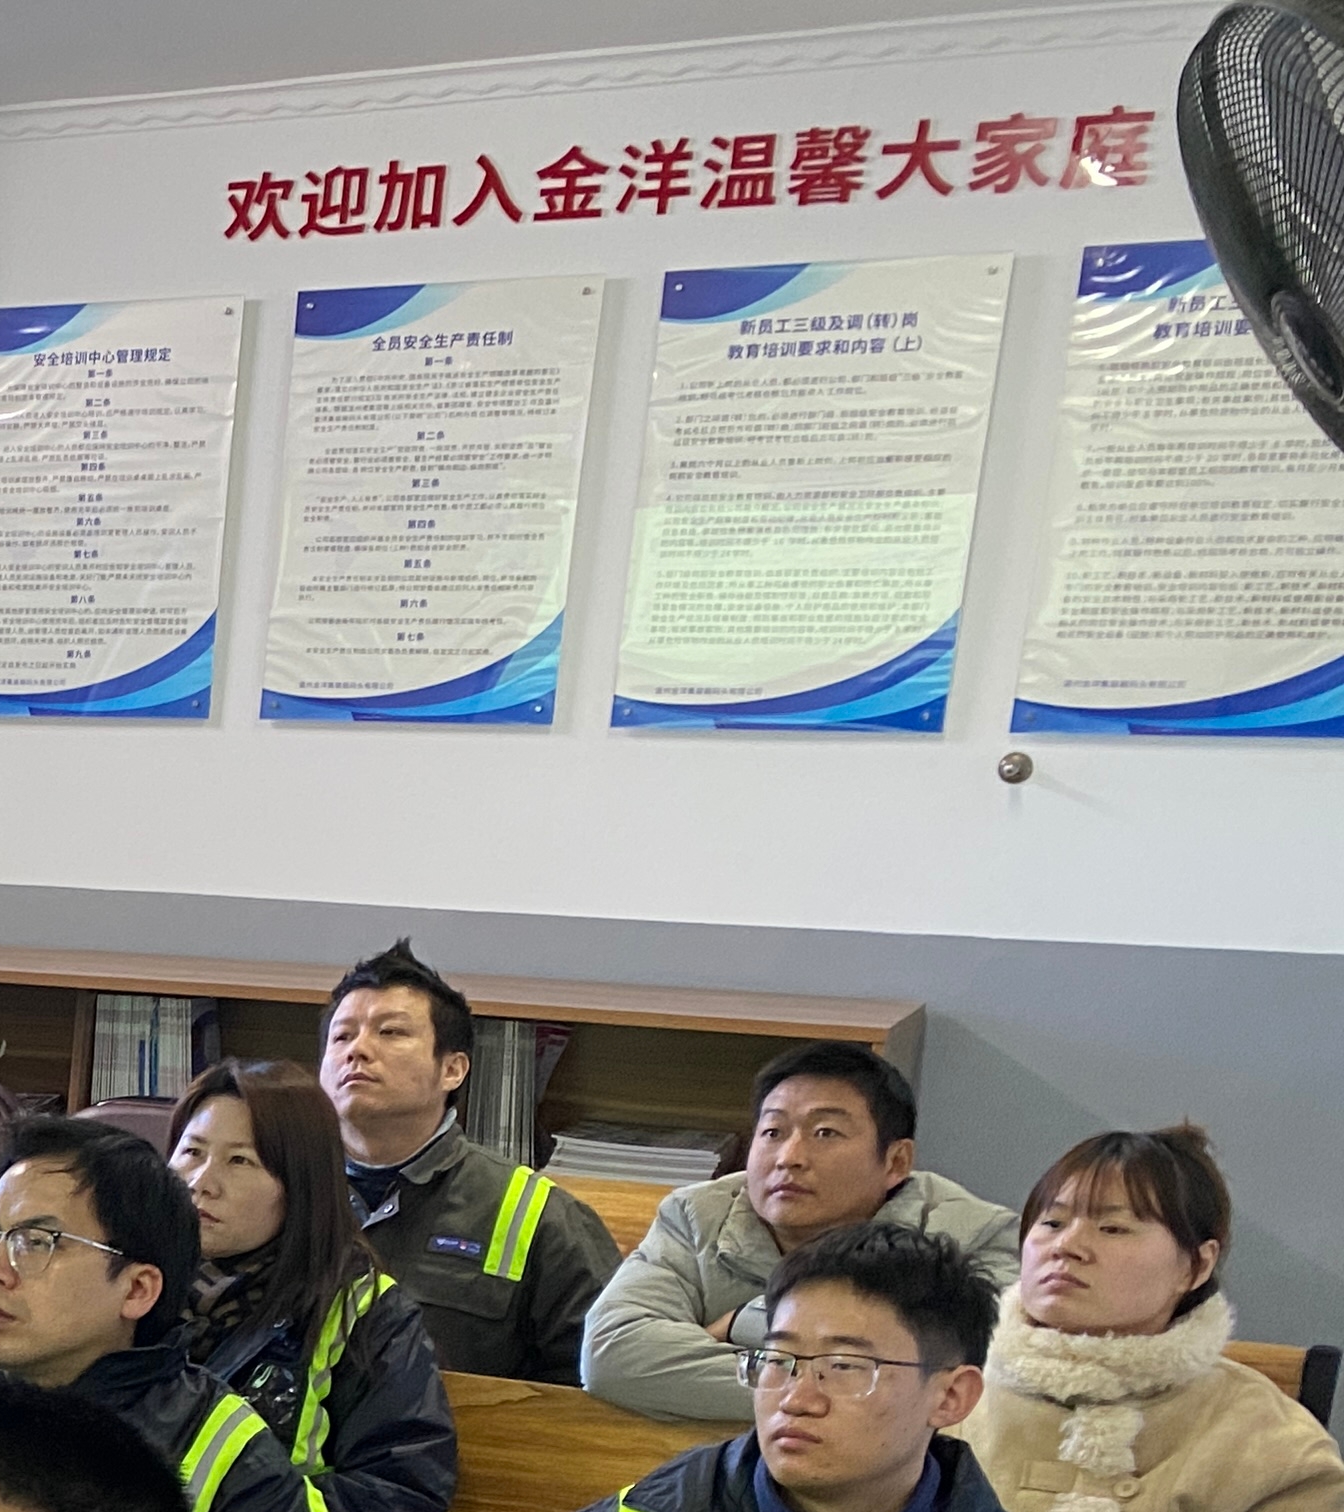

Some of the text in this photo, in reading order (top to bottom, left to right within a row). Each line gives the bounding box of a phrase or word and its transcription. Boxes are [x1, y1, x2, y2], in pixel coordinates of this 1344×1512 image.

[223, 104, 1157, 245] 欢迎加入金洋温馨大家庭
[372, 330, 514, 352] 全员安全生产责任制
[33, 347, 172, 368] 安全培训中心管理规定
